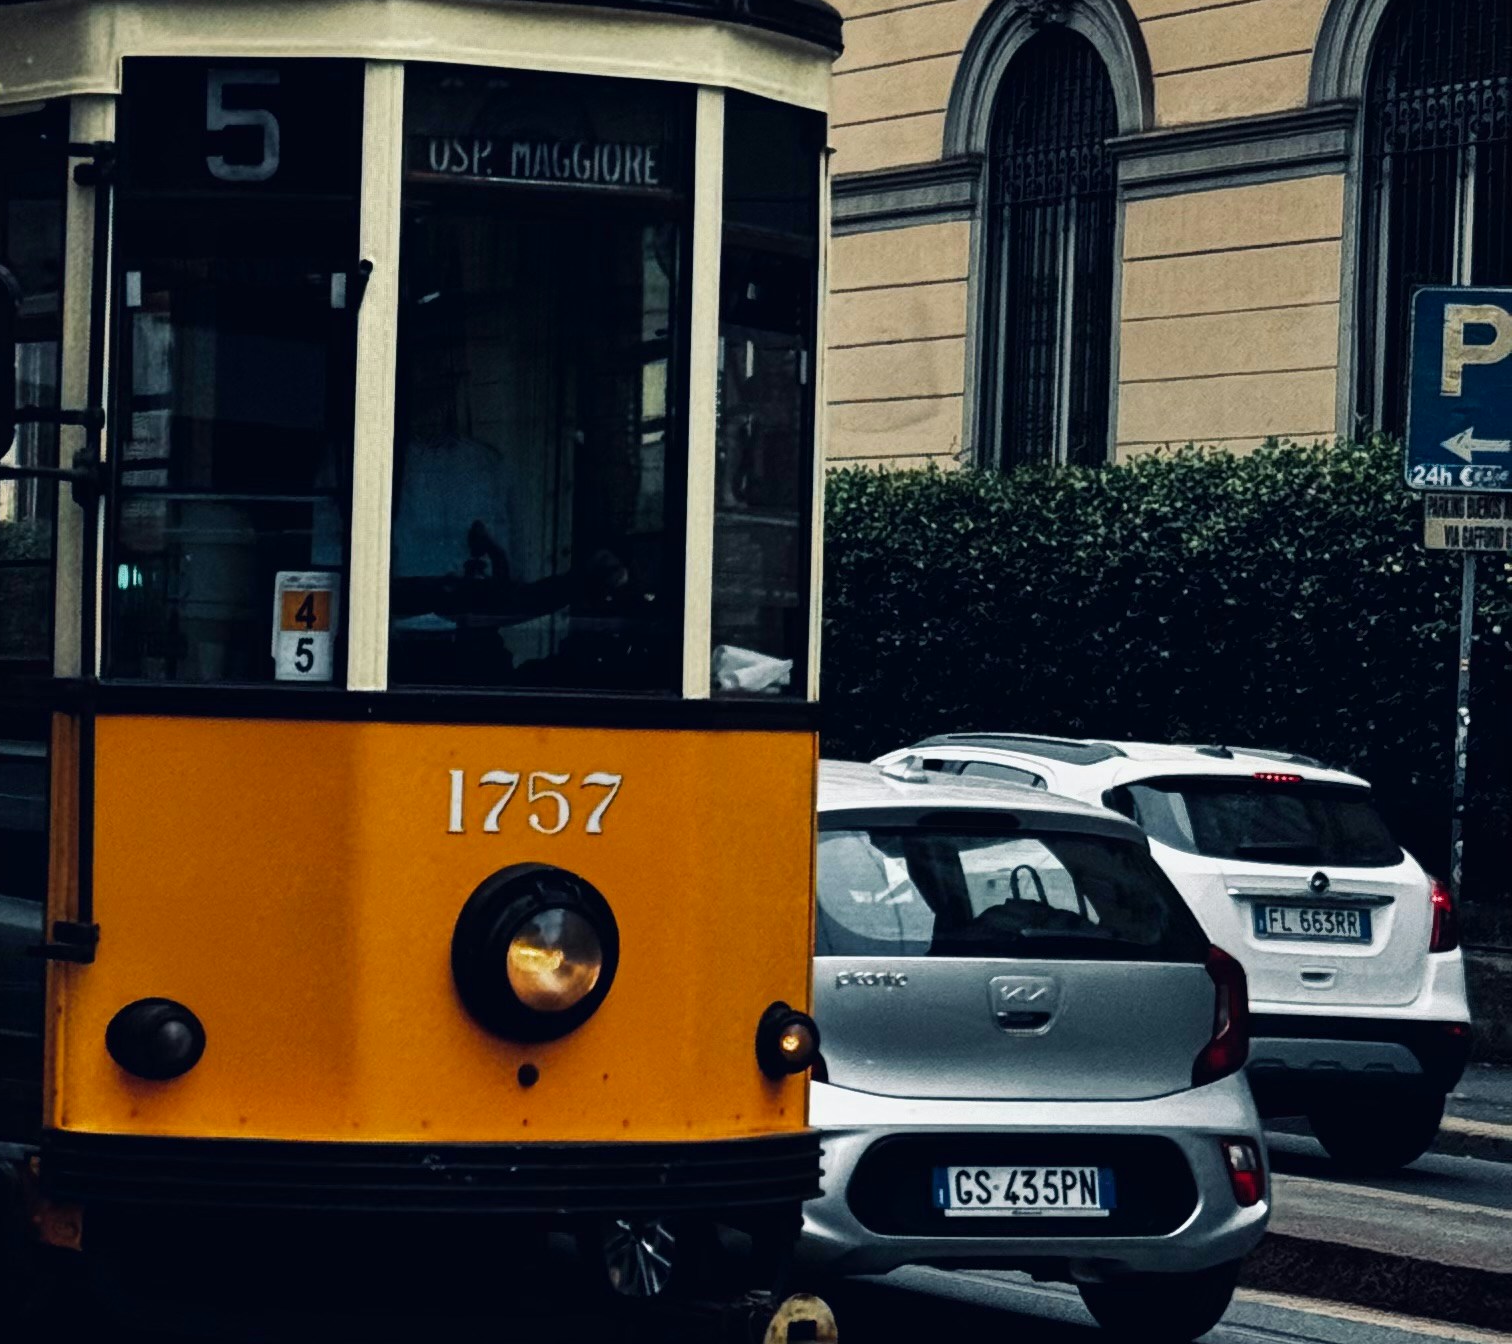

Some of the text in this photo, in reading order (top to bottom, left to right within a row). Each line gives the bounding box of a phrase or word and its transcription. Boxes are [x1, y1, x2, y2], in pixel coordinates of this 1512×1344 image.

[206, 69, 280, 181] 5
[511, 141, 660, 185] MAGGIORE
[1440, 304, 1512, 396] P
[1412, 465, 1452, 486] 24h
[295, 592, 316, 630] 4
[294, 637, 314, 674] 5
[446, 768, 623, 835] 1757
[1268, 908, 1358, 936] FL 663RR
[954, 1169, 1098, 1206] GS 435PN
